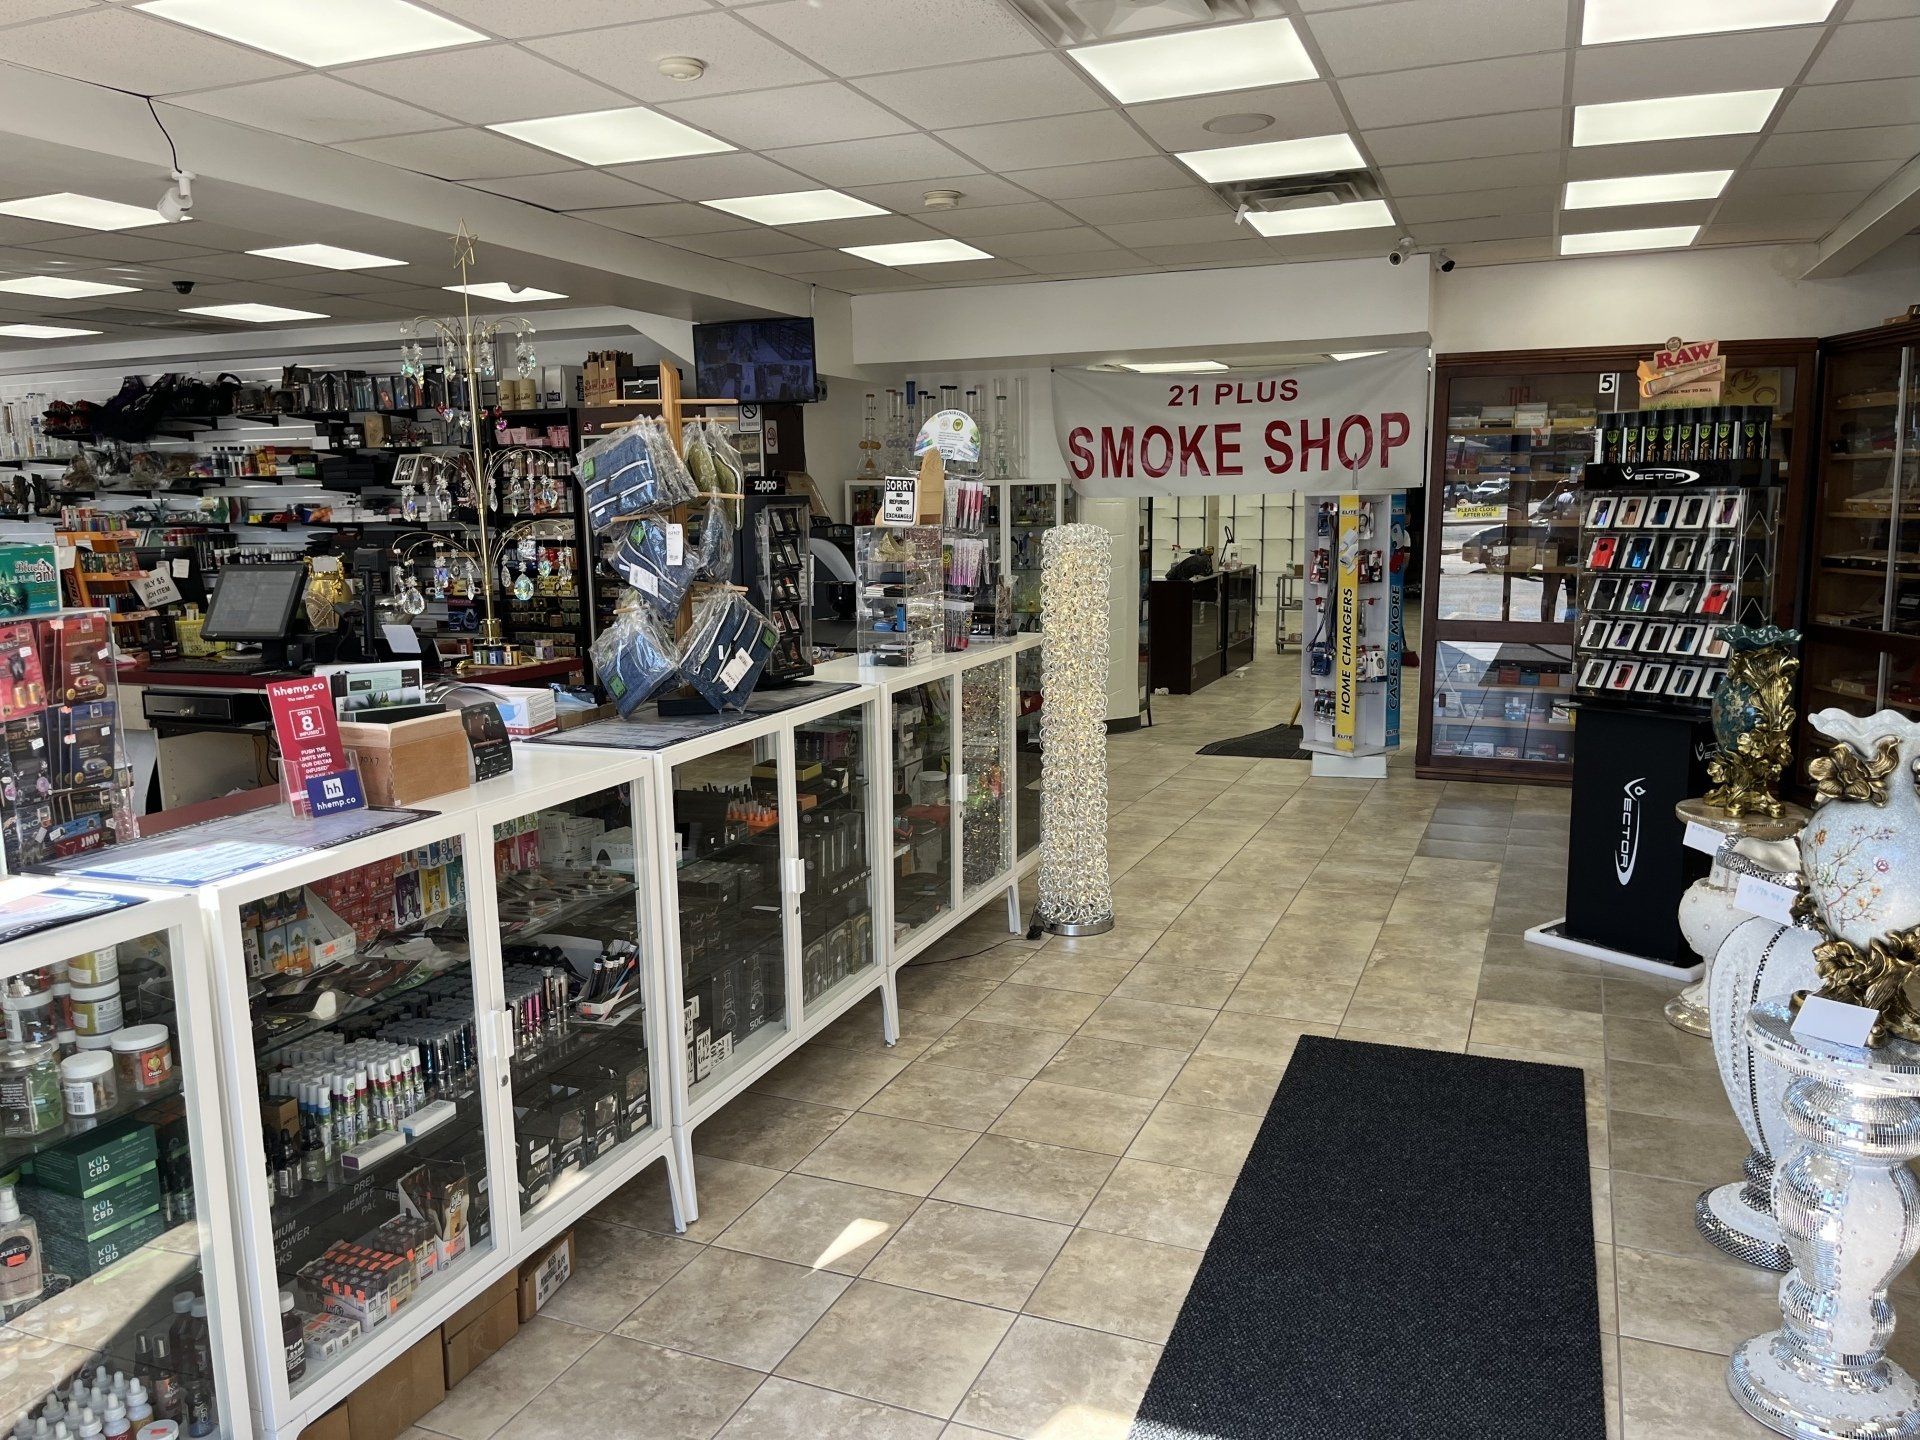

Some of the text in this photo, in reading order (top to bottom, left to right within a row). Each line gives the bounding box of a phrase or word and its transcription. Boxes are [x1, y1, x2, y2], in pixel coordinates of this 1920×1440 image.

[1656, 341, 1715, 369] RAW
[1601, 375, 1613, 391] 5
[1167, 378, 1299, 407] 21 PLUS
[1067, 411, 1411, 480] SMOKE SHOP
[1621, 466, 1686, 480] VECTOR
[886, 480, 913, 491] SORRY
[157, 576, 165, 584] $5
[1341, 587, 1353, 715] HOME CHARGERS
[1389, 585, 1400, 710] CASES & MORE
[273, 682, 324, 697] hhemp.co
[301, 715, 314, 731] 8
[325, 782, 341, 795] hh
[317, 797, 356, 810] hhemp.co
[1620, 778, 1646, 868] VECTOR
[89, 1164, 110, 1178] CBD
[93, 1207, 114, 1221] CBD
[98, 1251, 119, 1265] CBD
